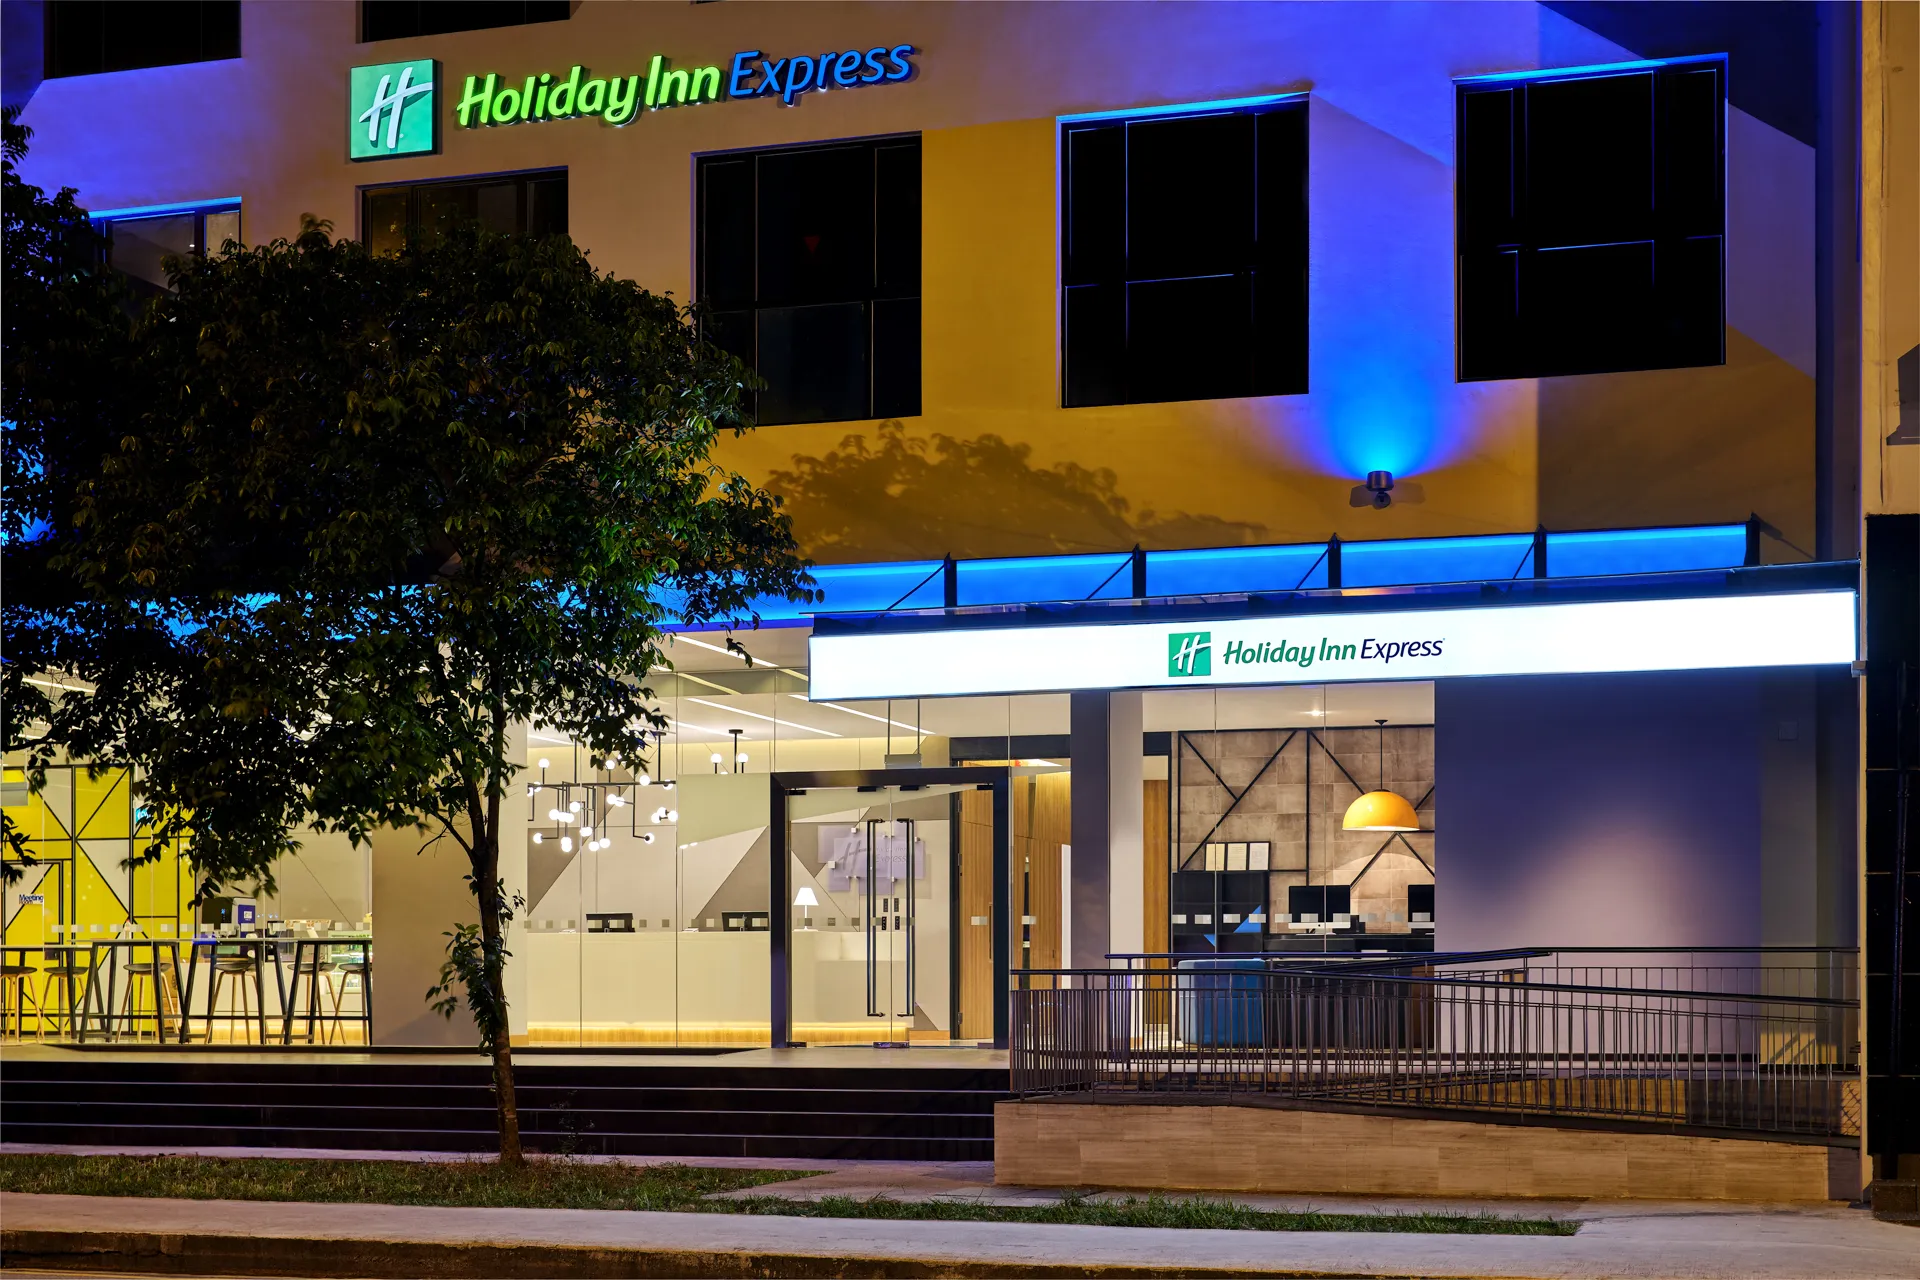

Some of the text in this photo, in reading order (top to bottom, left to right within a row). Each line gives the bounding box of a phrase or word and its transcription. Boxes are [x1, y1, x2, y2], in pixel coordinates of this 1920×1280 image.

[457, 45, 914, 125] Holiday Inn Express
[1223, 638, 1443, 668] Holiday Inn Express
